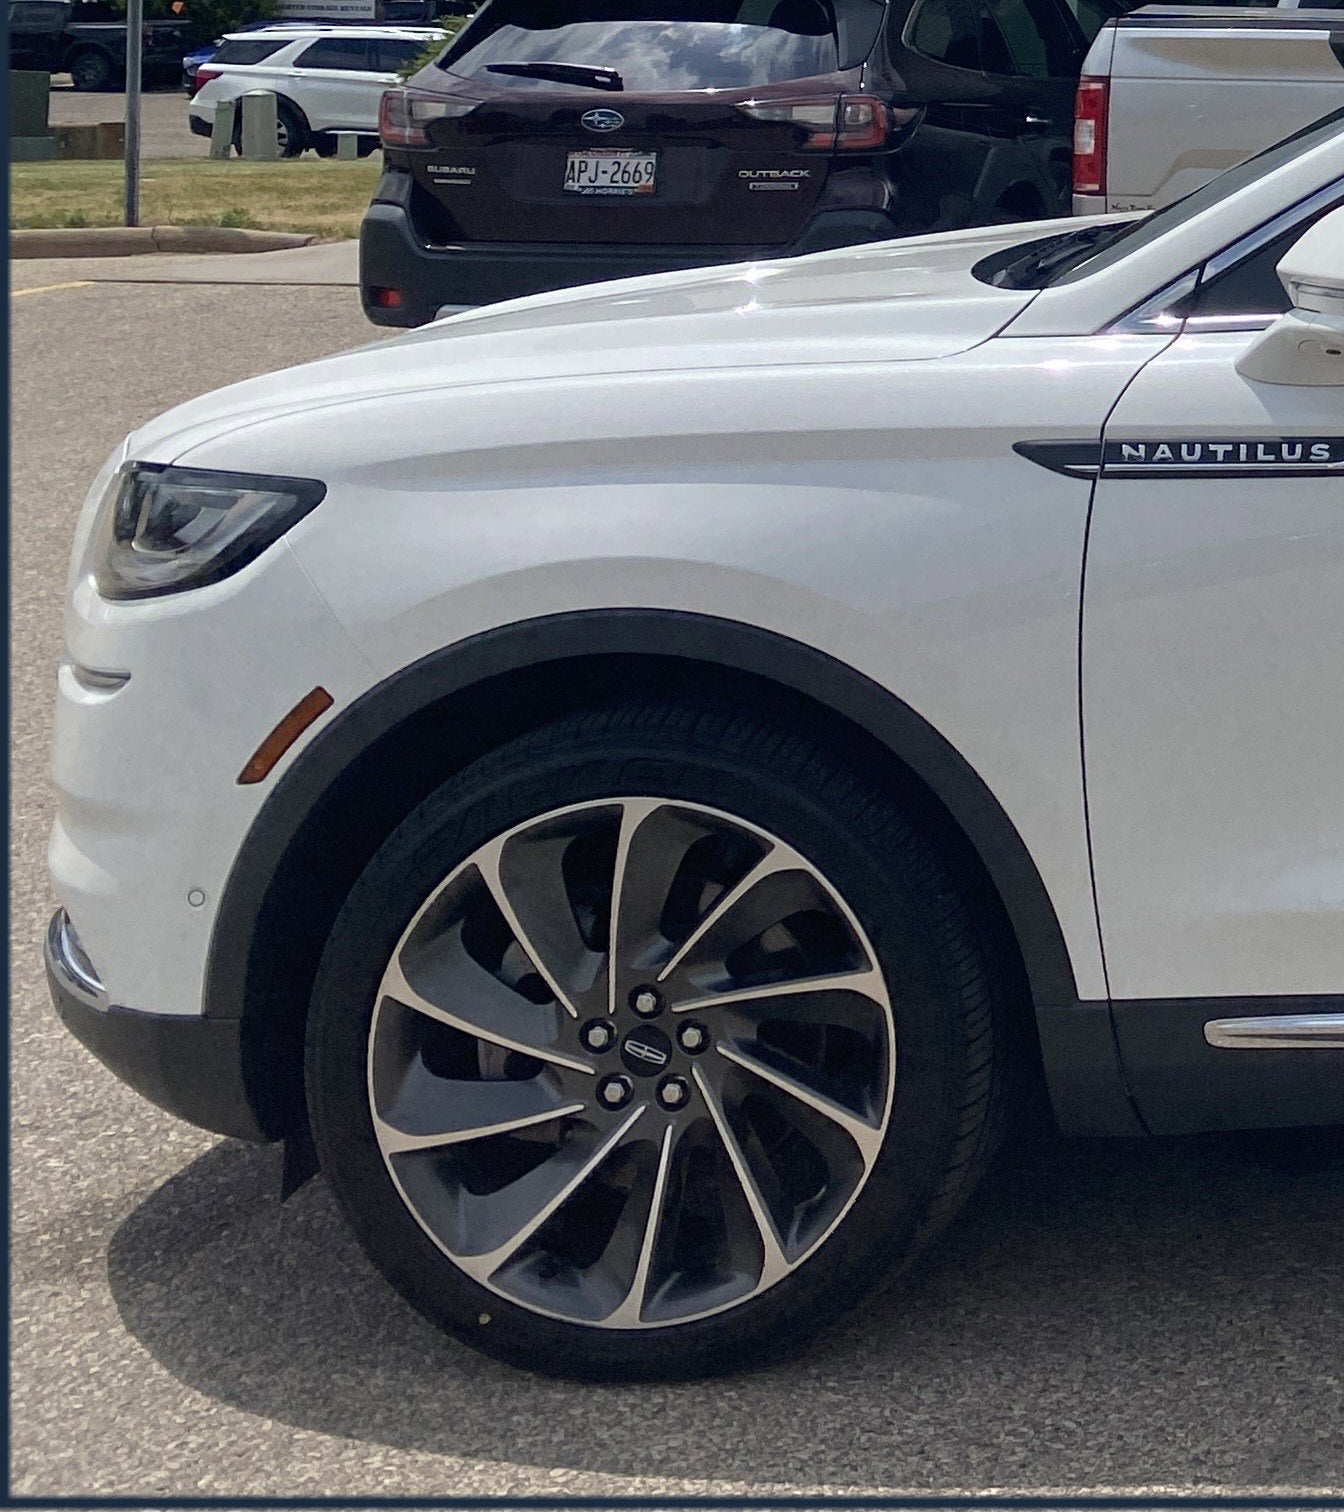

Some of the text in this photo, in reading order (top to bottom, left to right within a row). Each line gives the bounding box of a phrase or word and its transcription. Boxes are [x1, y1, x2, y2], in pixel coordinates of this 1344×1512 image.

[426, 165, 476, 175] SUBARU
[565, 159, 654, 184] APJ-2669
[738, 169, 810, 178] OUTBACK
[1120, 442, 1332, 463] NAUTILUS
